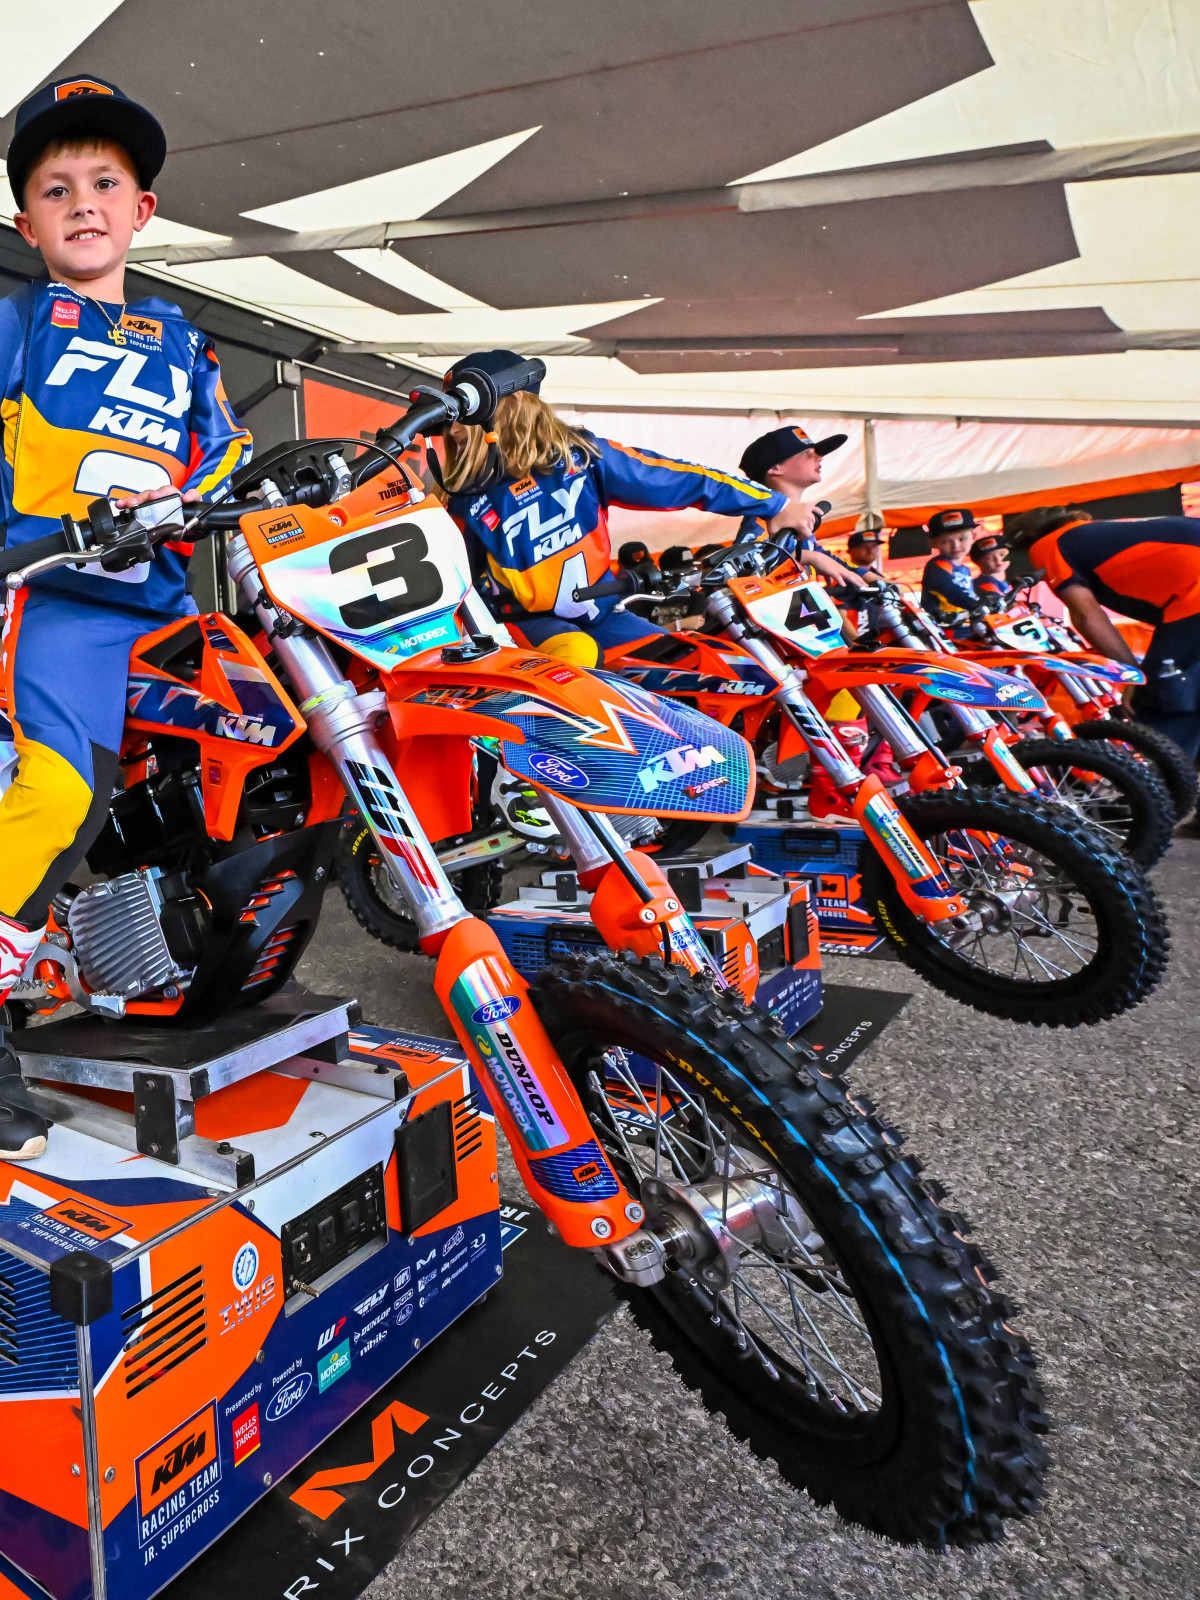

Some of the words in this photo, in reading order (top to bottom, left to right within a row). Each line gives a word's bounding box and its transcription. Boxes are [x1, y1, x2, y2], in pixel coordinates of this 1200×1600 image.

[54, 312, 78, 320] FARGO
[55, 306, 78, 314] WELLS
[126, 320, 157, 333] KTM
[45, 336, 191, 419] FLY
[88, 404, 181, 452] KTM
[378, 484, 409, 501] TUBBS
[514, 479, 533, 493] KTM
[268, 520, 293, 534] KTM
[502, 475, 587, 558] FLY
[267, 532, 288, 545] RACING
[288, 528, 304, 538] TEAM
[533, 522, 583, 562] KTM
[329, 522, 443, 630] 3
[553, 551, 600, 621] 4
[784, 587, 833, 632] 4
[400, 625, 449, 650] MOTOREX
[717, 680, 766, 696] KTM
[216, 713, 277, 747] KTM
[535, 756, 575, 785] Ford
[637, 744, 727, 794] KTM
[352, 828, 369, 853] DUNLO
[891, 825, 925, 868] DUNLOP
[822, 898, 847, 908] TEAM
[482, 1000, 515, 1023] Ford
[825, 1020, 873, 1063] ONCEPTS
[487, 1057, 536, 1133] MOTOREX
[496, 1032, 555, 1127] DUNLOP
[578, 1165, 597, 1178] KTM
[31, 1212, 69, 1237] RACING
[68, 1230, 99, 1250] TEAM
[58, 1208, 112, 1233] KTM
[218, 1274, 275, 1326] TWIG
[353, 1282, 390, 1315] FLY
[394, 1288, 414, 1310] OGIO
[317, 1316, 347, 1351] WP
[360, 1307, 392, 1337] DUNLOP
[360, 1330, 388, 1357] nihilo
[272, 1362, 296, 1387] Powered
[296, 1358, 303, 1368] by
[320, 1352, 350, 1383] MOTOREX
[225, 1387, 255, 1417] Presented
[255, 1382, 262, 1393] by
[274, 1380, 305, 1417] Ford
[235, 1415, 257, 1439] WELLS
[235, 1426, 258, 1450] FARGO
[151, 1430, 207, 1496] KTM
[283, 1527, 365, 1600] RIX
[377, 1330, 557, 1509] CONCEPTS
[142, 1490, 186, 1540] RACING
[190, 1461, 219, 1498] TEAM
[144, 1546, 158, 1566] JR.
[161, 1489, 220, 1550] SUPERCROSS
